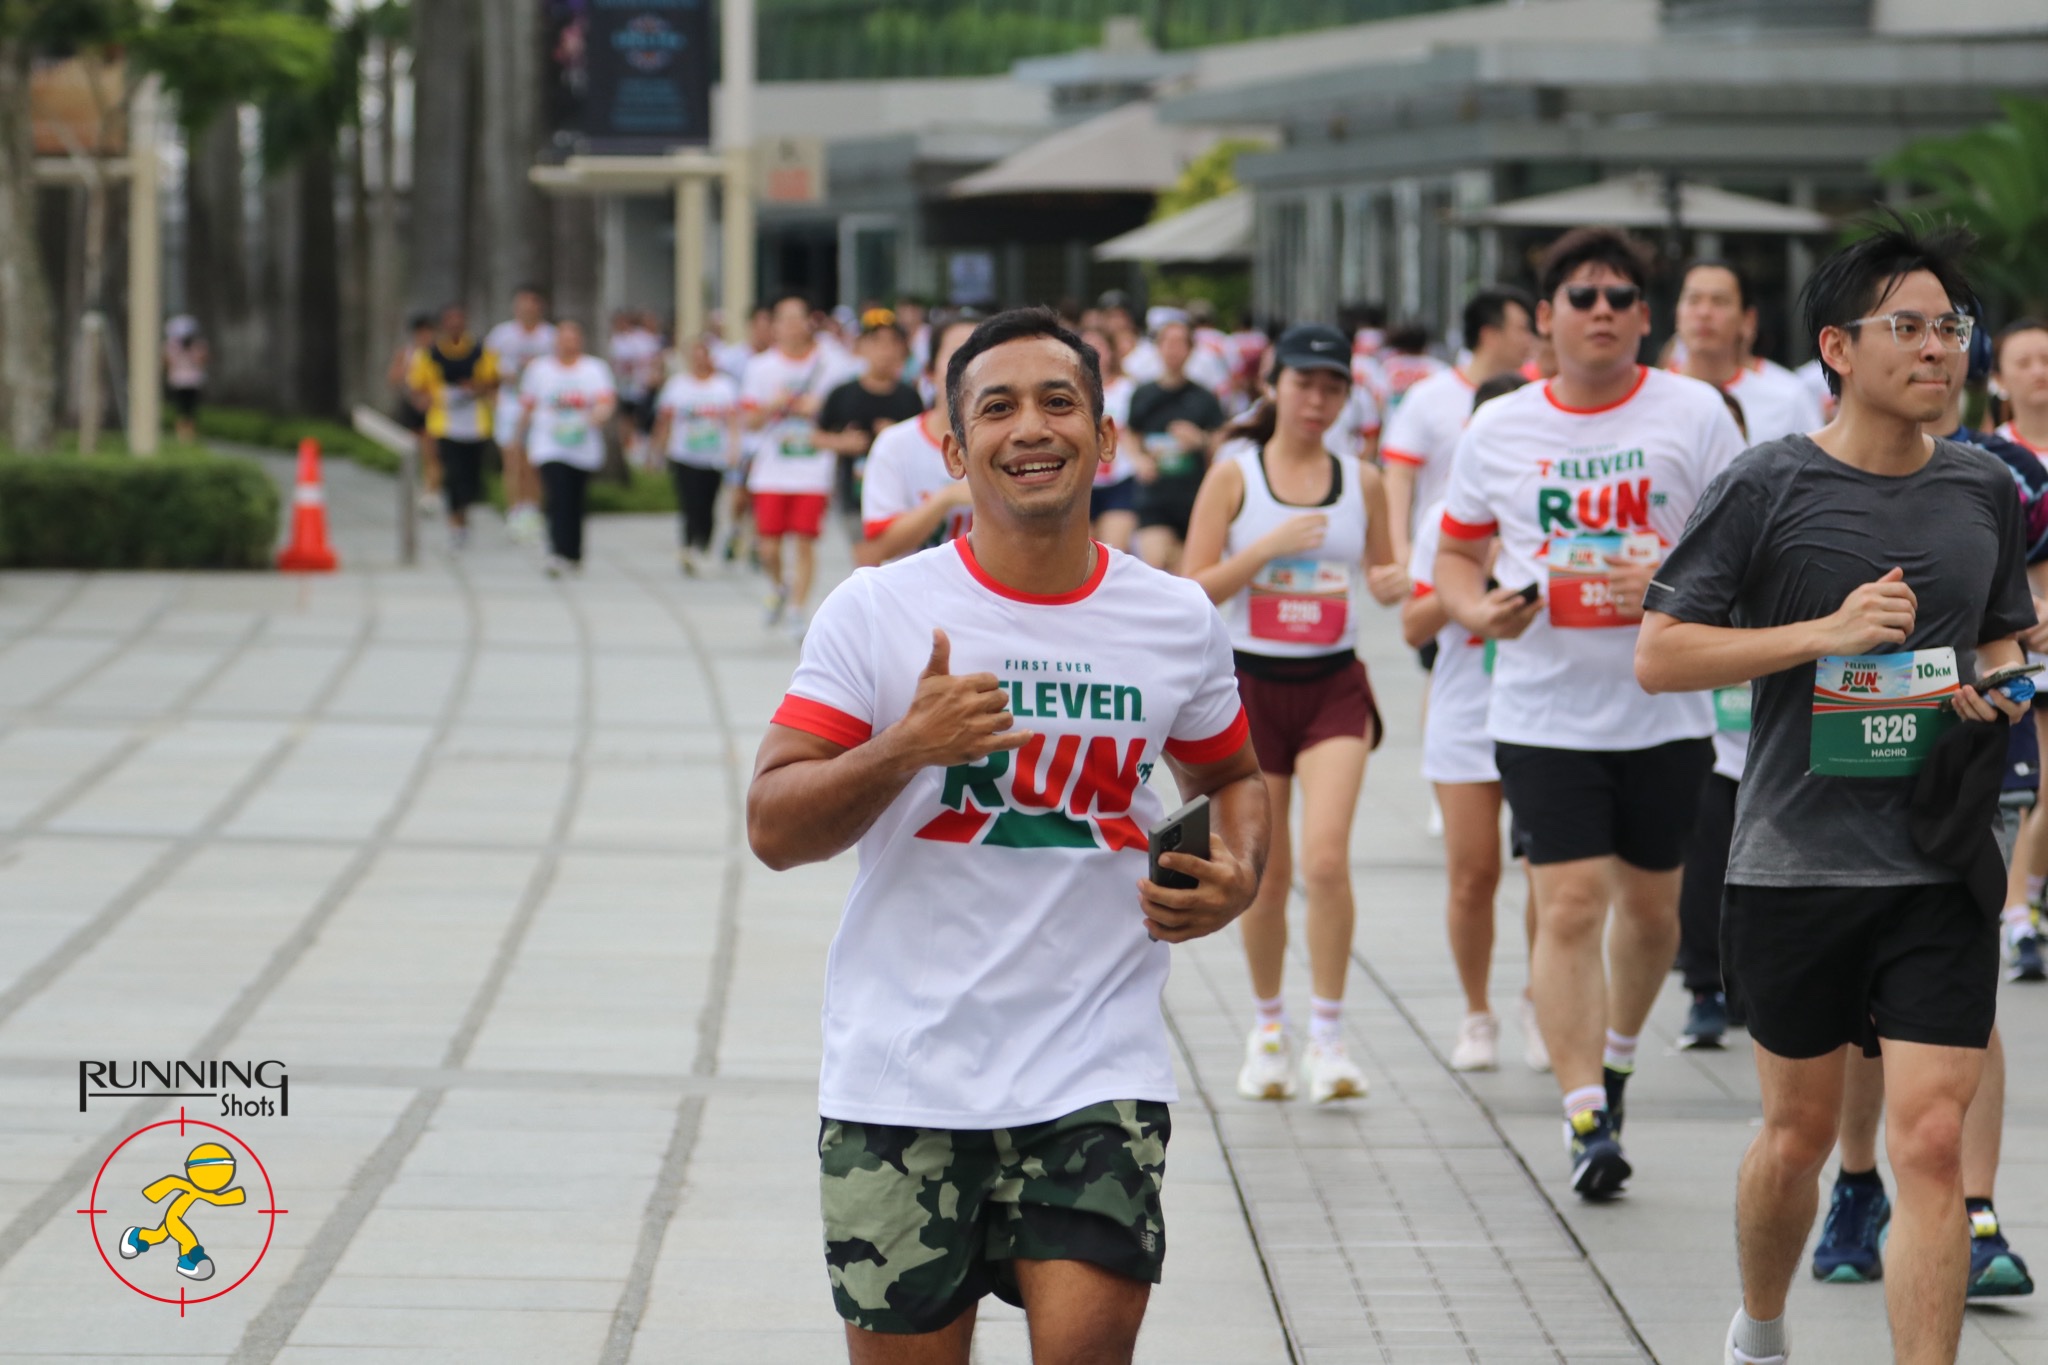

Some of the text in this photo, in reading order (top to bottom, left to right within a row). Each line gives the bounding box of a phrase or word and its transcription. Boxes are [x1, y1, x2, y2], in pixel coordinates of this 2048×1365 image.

[1538, 478, 1652, 534] RUN
[1005, 659, 1092, 673] FIRST EVER
[1916, 663, 1951, 679] 10KM
[1842, 670, 1878, 686] RUN
[1861, 713, 1917, 744] 1326
[1871, 748, 1907, 757] HACHIQ
[940, 733, 1147, 815] RUN
